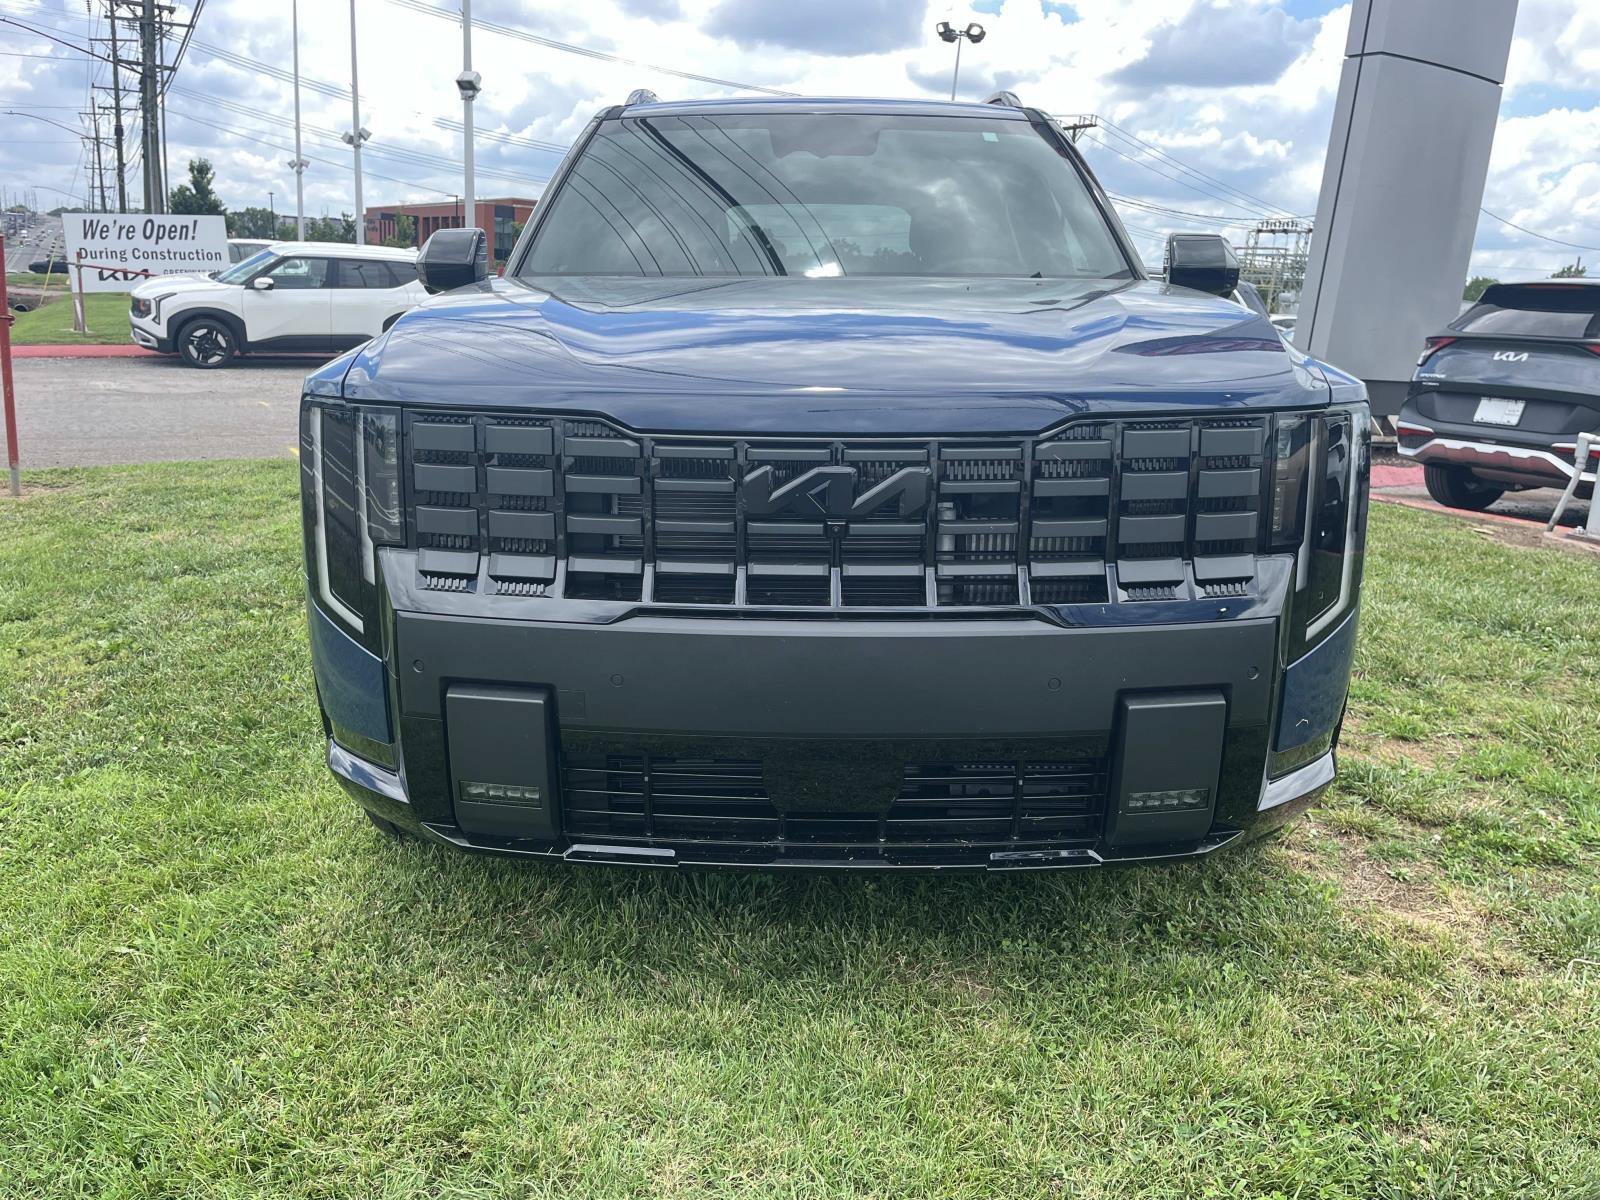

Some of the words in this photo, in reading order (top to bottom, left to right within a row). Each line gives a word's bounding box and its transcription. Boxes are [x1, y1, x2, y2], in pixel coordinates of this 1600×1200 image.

[82, 218, 136, 240] We're
[142, 218, 198, 245] Open!
[80, 247, 128, 262] During
[132, 248, 222, 261] Construction
[1493, 352, 1529, 362] KIA
[742, 465, 931, 517] KIA
